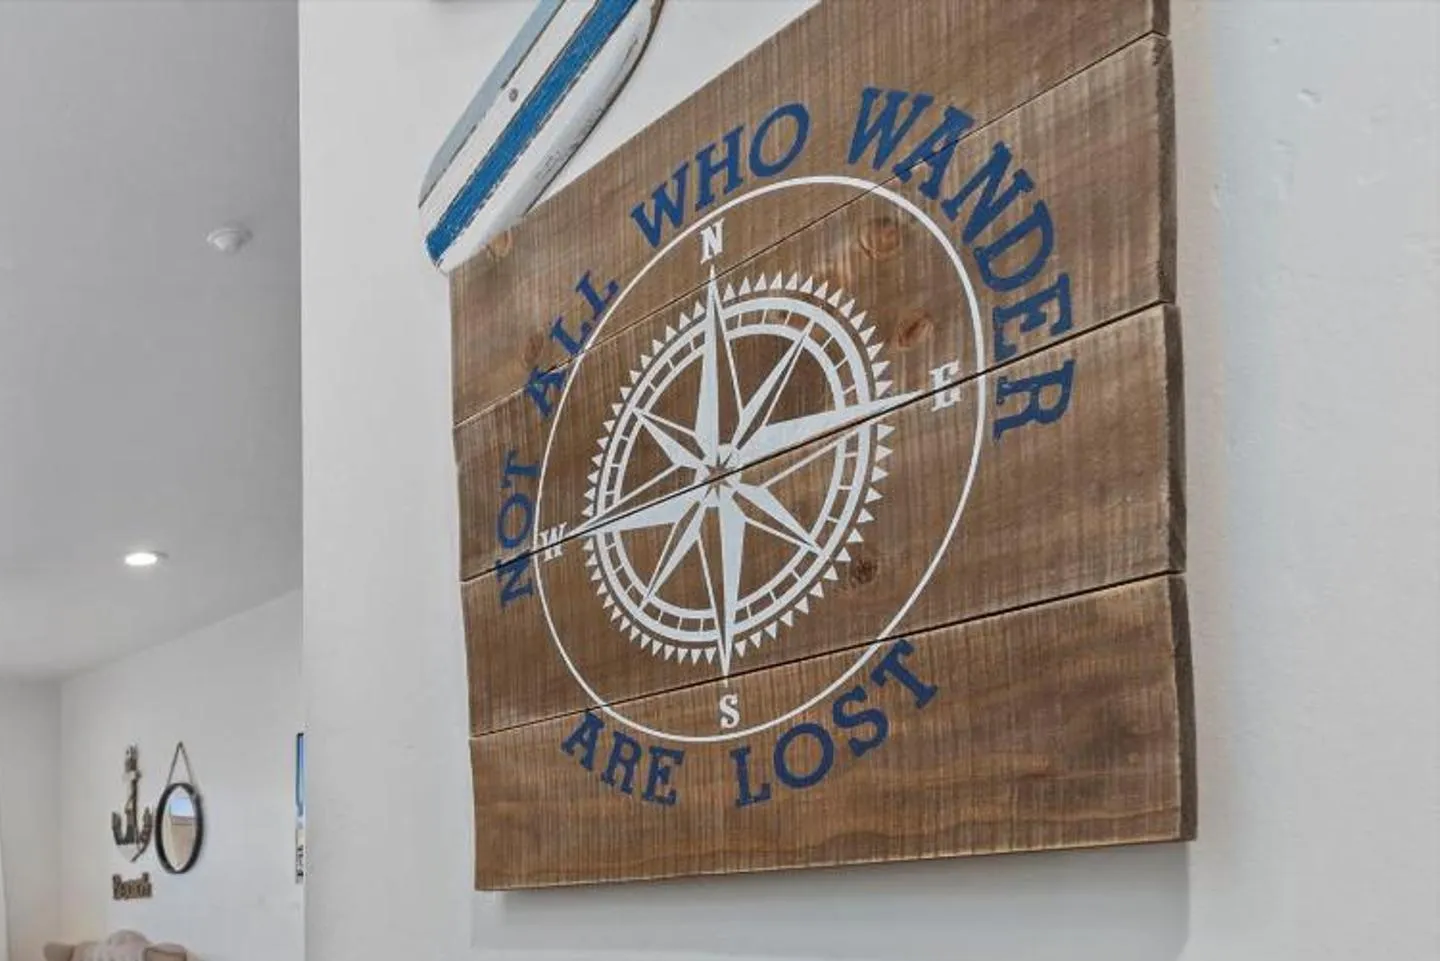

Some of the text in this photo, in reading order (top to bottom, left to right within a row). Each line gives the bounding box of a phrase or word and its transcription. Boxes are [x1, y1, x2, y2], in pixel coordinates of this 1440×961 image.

[699, 221, 725, 257] N
[495, 86, 1075, 608] NOT ALL WHO WANDER
[536, 522, 567, 564] W
[560, 640, 938, 808] ARE LOST
[718, 694, 740, 729] S
